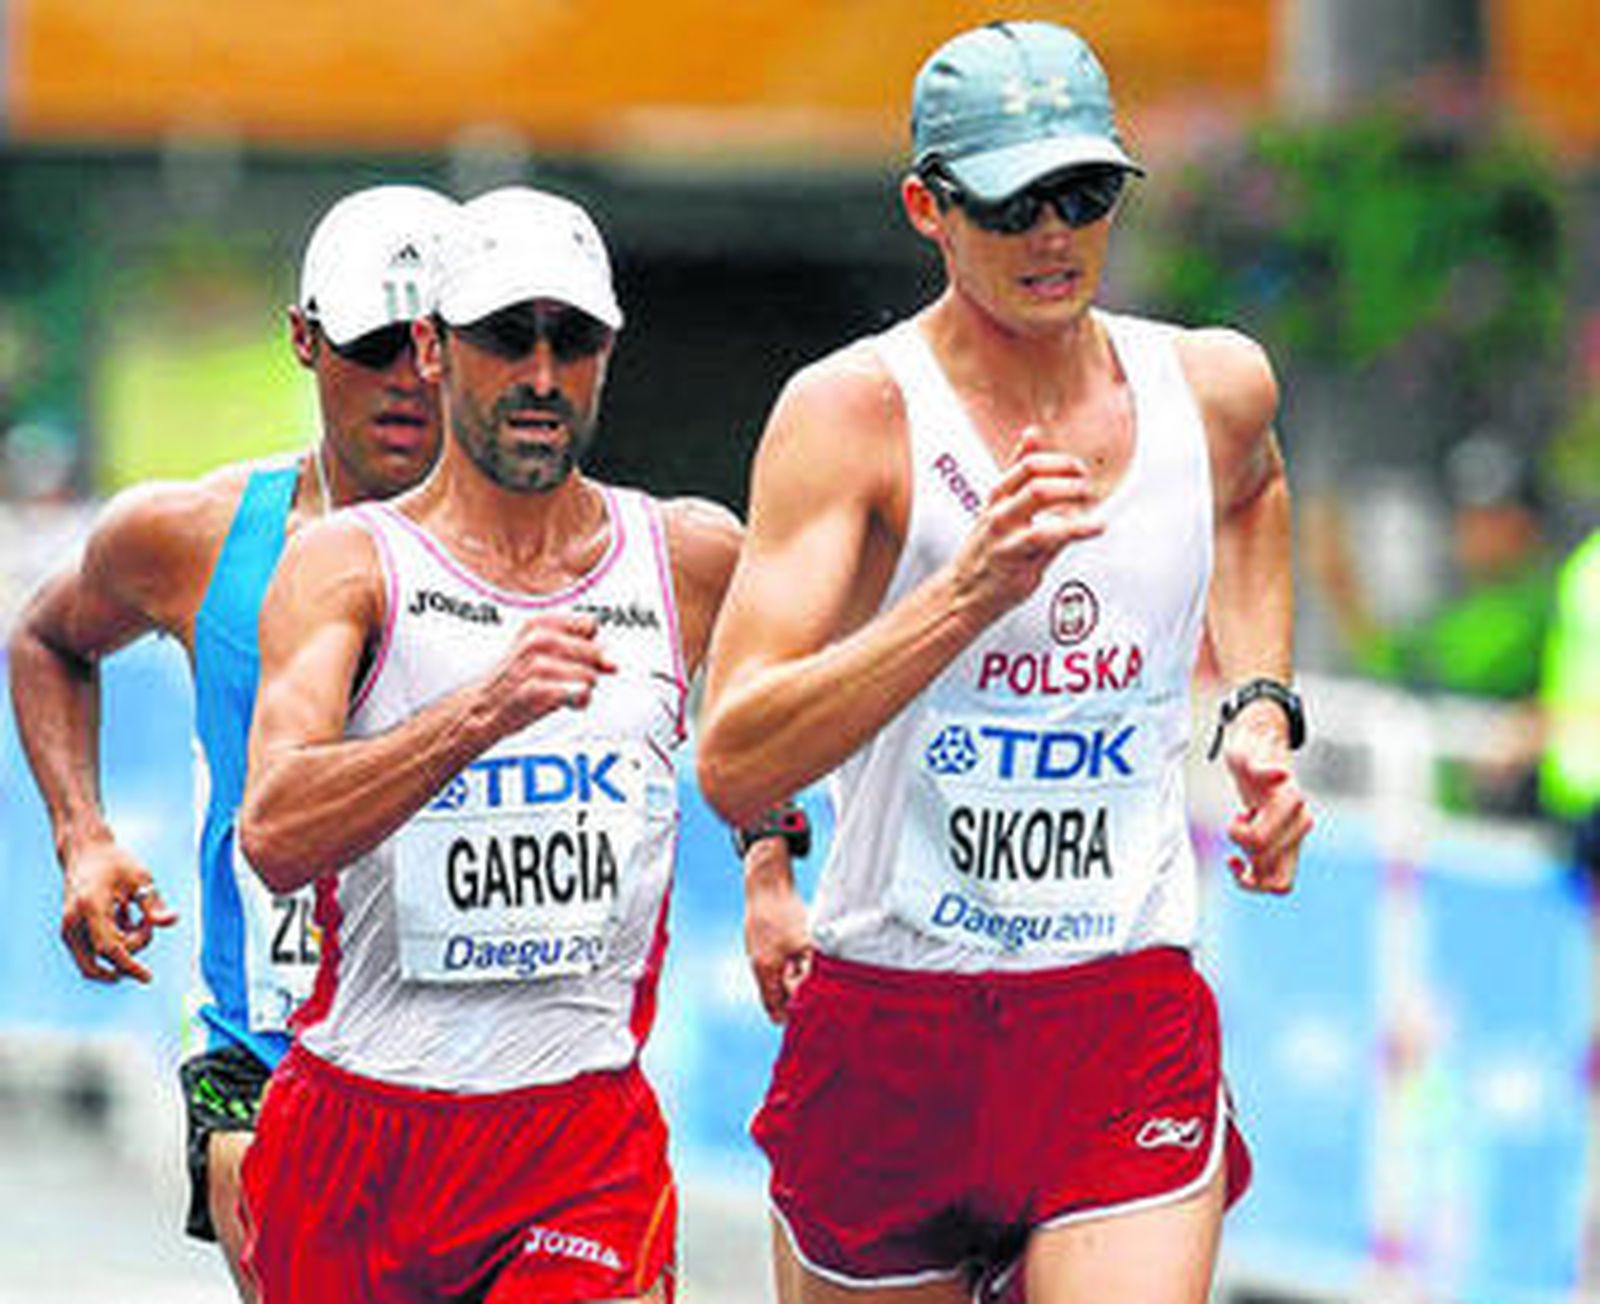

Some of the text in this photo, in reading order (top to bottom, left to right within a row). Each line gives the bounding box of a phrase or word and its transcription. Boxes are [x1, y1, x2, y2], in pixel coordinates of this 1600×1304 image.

[977, 646, 1143, 695] POLSKA
[979, 725, 1137, 779] TDK
[468, 753, 627, 807] TDK
[447, 811, 619, 912] GARCÍA
[949, 806, 1113, 880] SIKORA
[931, 892, 1053, 950] Daegu
[443, 934, 604, 976] Daegu 20
